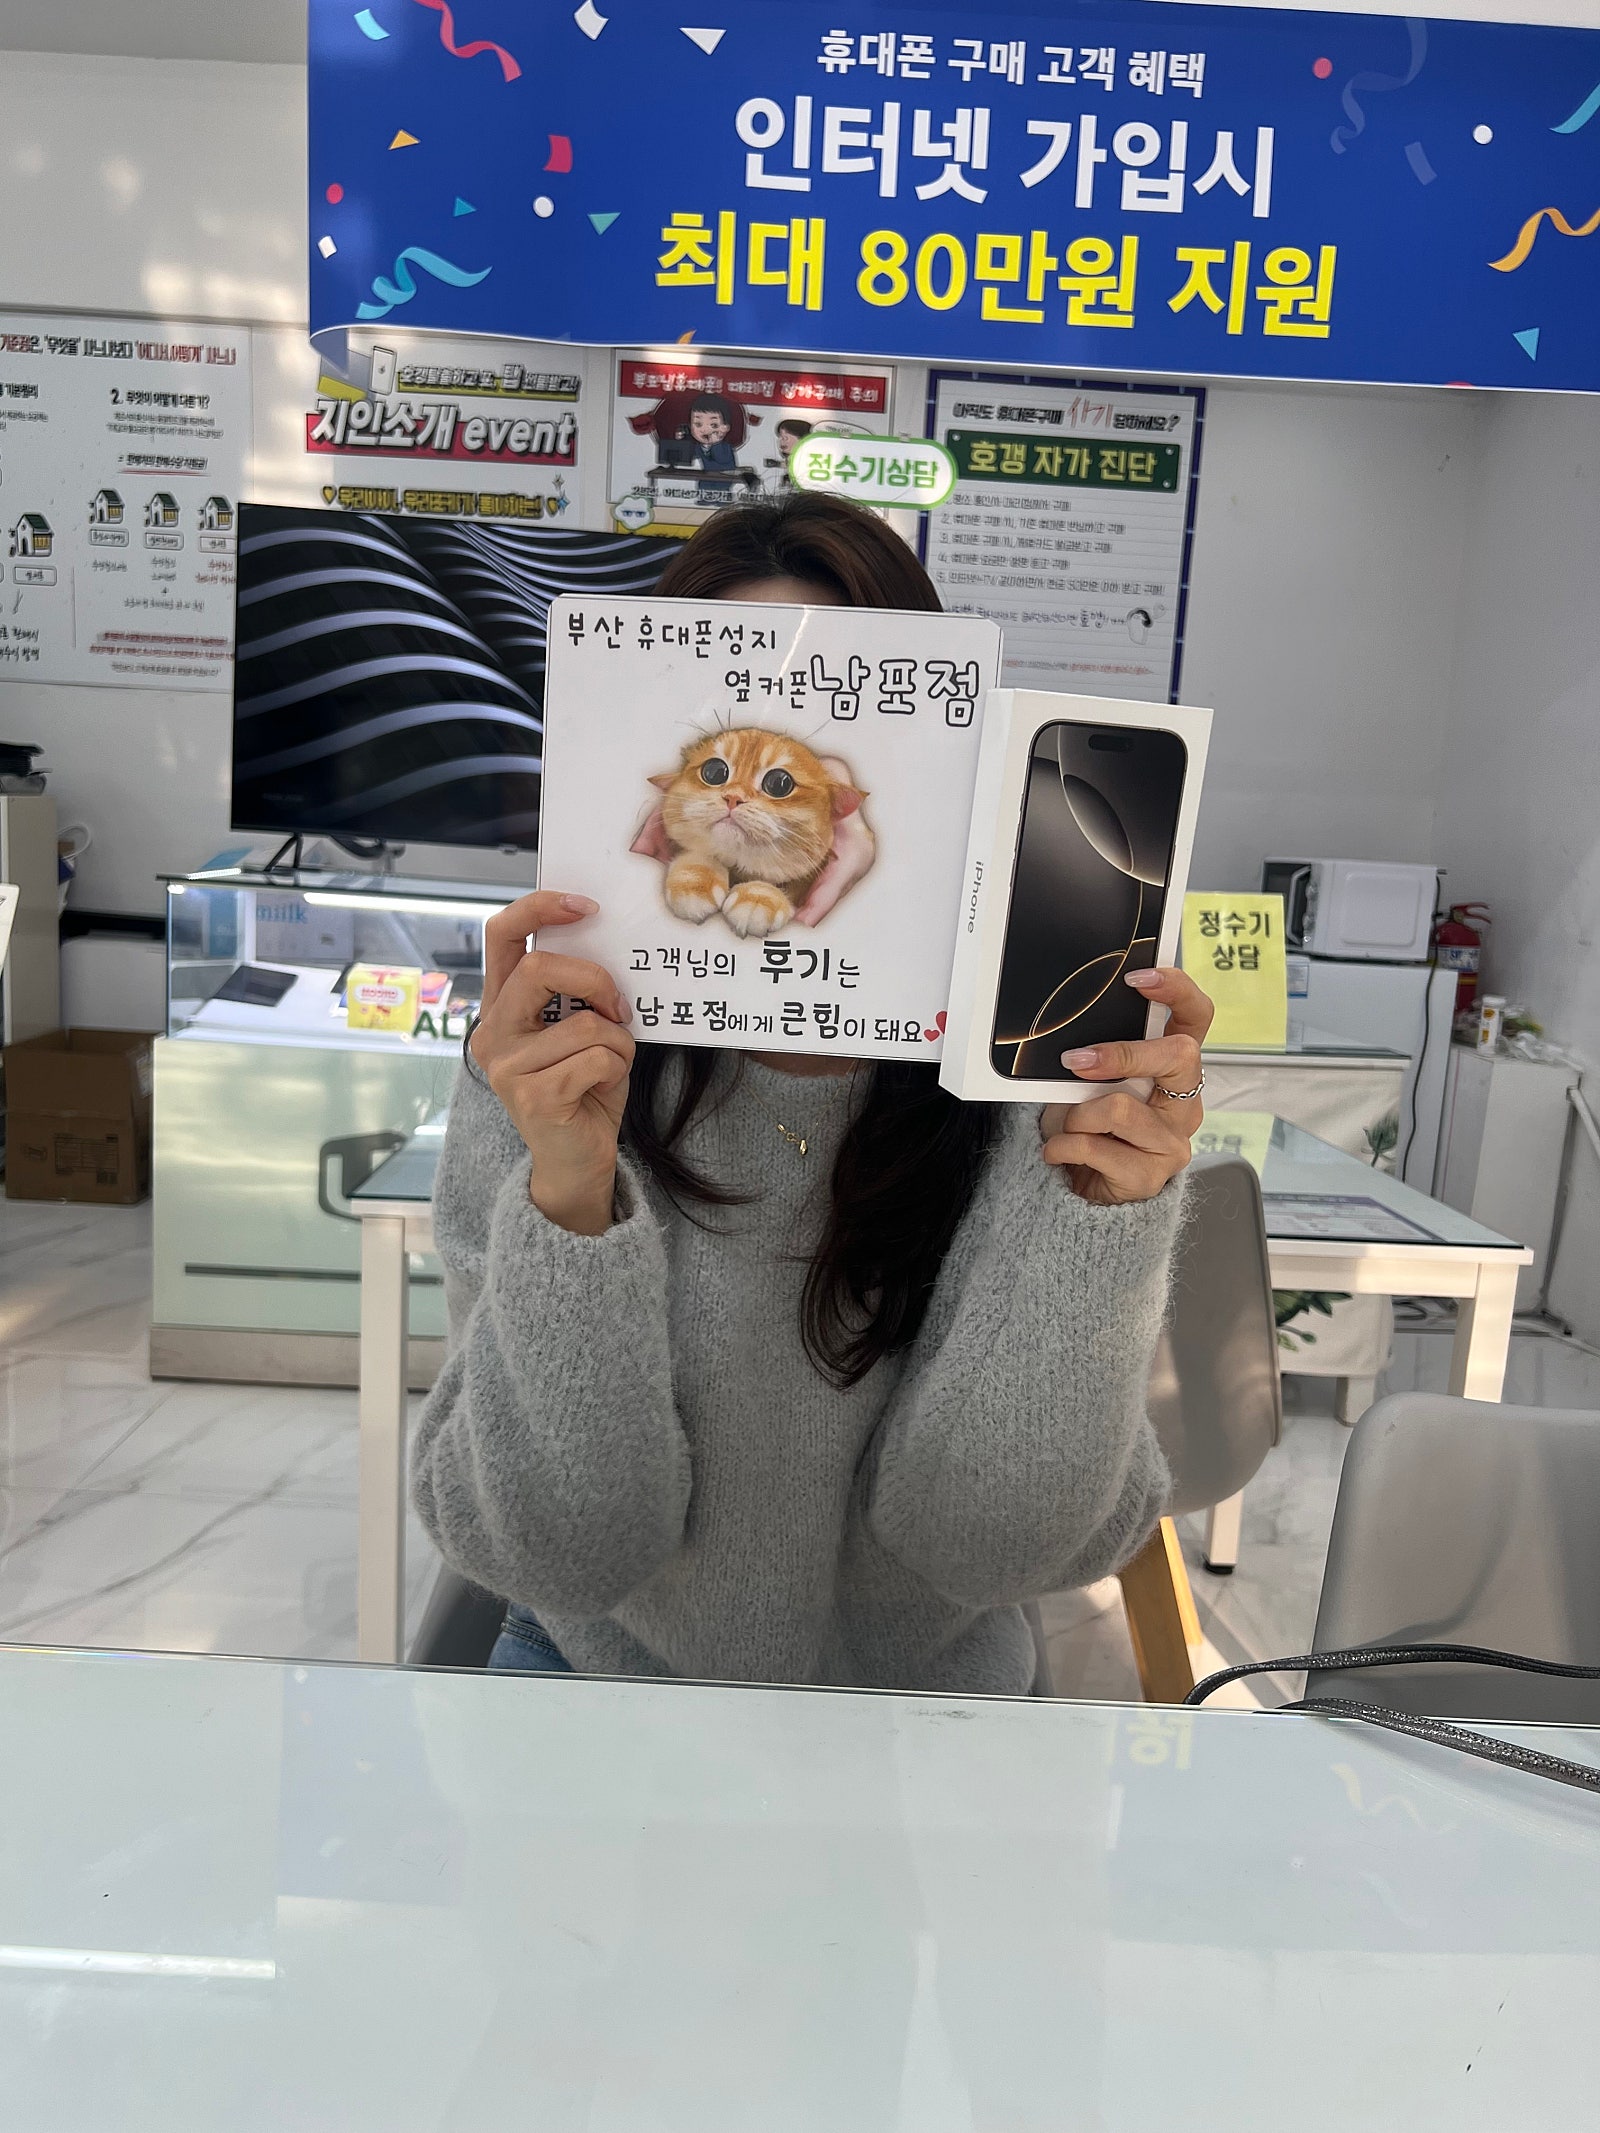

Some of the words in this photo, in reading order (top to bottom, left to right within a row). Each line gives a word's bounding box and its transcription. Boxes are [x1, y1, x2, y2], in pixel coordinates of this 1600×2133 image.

[818, 29, 937, 81] 휴대폰
[947, 38, 1026, 86] 구매
[1037, 44, 1116, 93] 고객
[1128, 49, 1206, 99] 혜택
[734, 94, 989, 205] 인터넷
[1019, 112, 1276, 220] 가입시
[655, 210, 825, 312] 최대
[856, 228, 1139, 329] 80만원
[1167, 243, 1339, 340] 지원
[309, 398, 460, 453] 지인소개
[462, 411, 578, 457] event
[808, 452, 939, 490] 정수기상담
[966, 439, 1028, 476] 호갱
[1031, 445, 1094, 479] 자가
[1098, 449, 1158, 482] 진단
[568, 612, 624, 649] 부산
[637, 614, 777, 659] 휴대폰성지
[725, 669, 807, 709] 옆커폰
[810, 654, 980, 728] 남포점
[967, 860, 984, 934] iPhone
[1199, 911, 1270, 938] 정수기
[628, 948, 737, 979] 고객님의
[759, 940, 861, 989] 후기는
[1212, 944, 1260, 971] 상담
[412, 1009, 469, 1041] AL
[635, 997, 774, 1034] 남포점에게
[873, 1017, 923, 1043] 돼요
